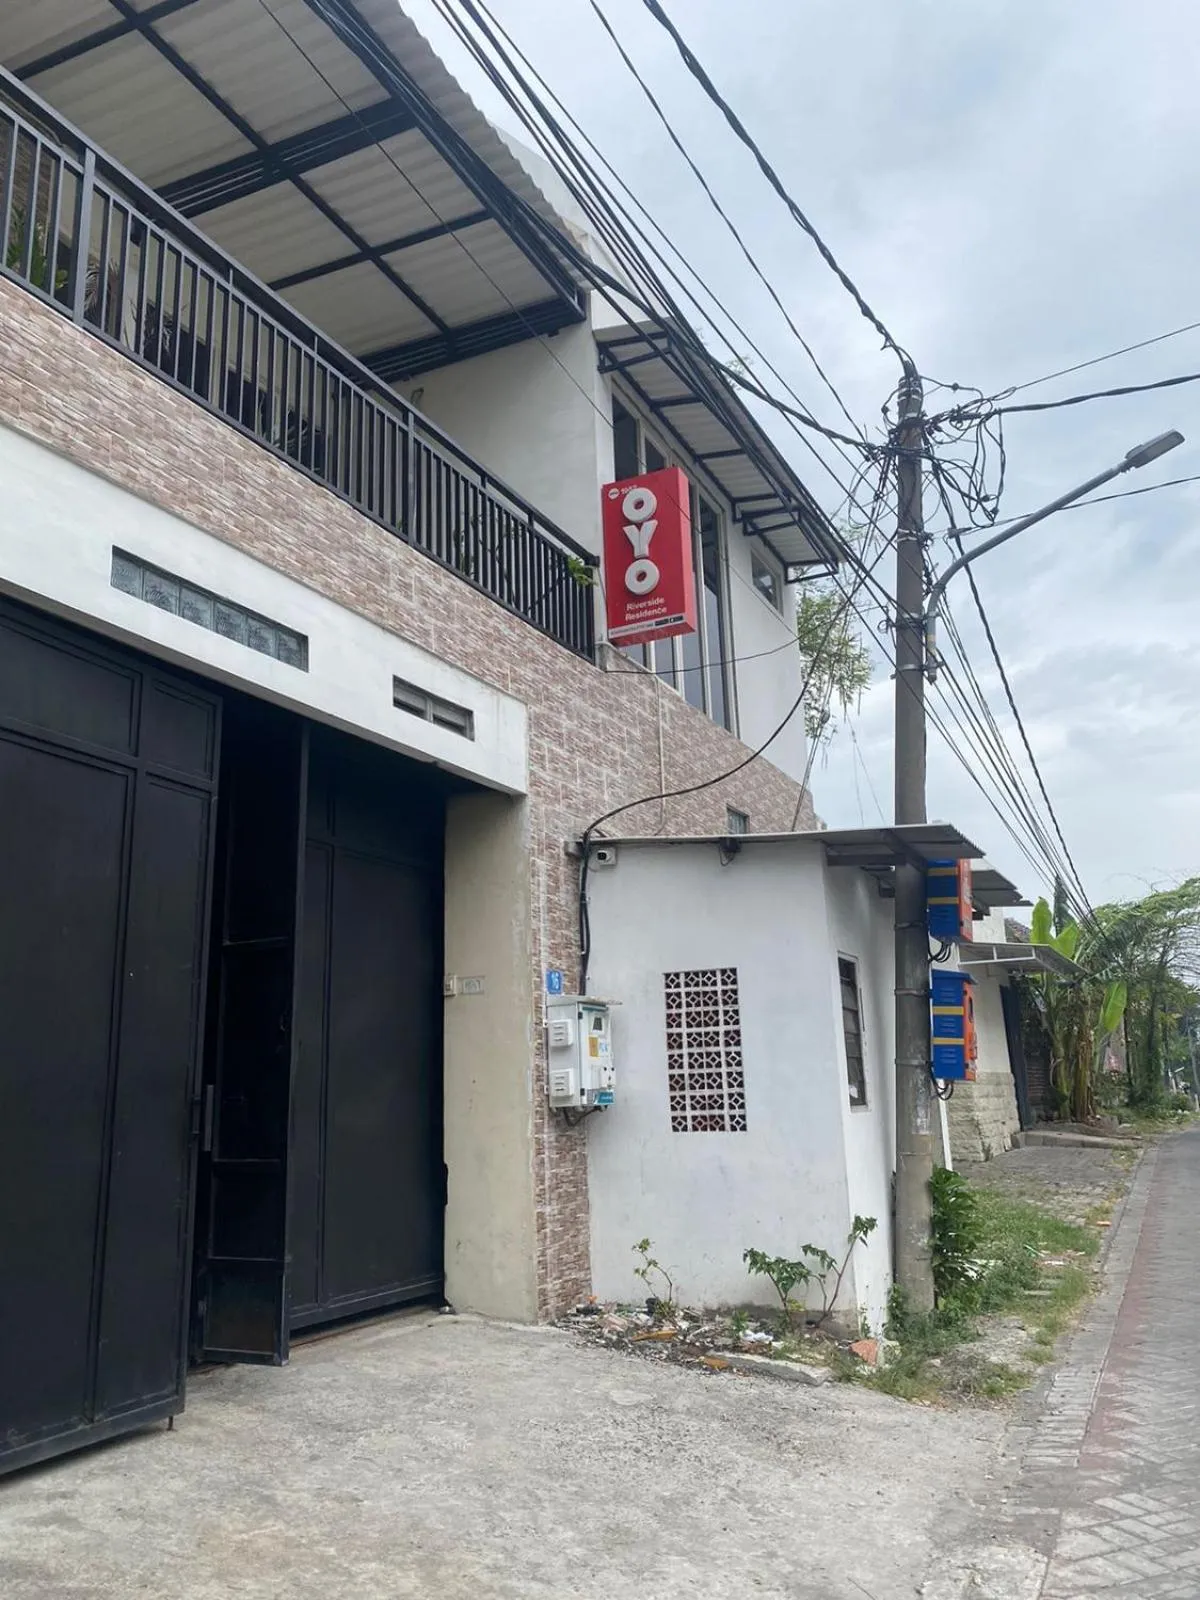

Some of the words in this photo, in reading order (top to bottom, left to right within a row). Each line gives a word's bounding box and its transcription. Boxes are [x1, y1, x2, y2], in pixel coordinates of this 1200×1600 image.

[622, 487, 660, 596] OYO
[626, 596, 665, 611] Riverside
[625, 606, 667, 621] Residence
